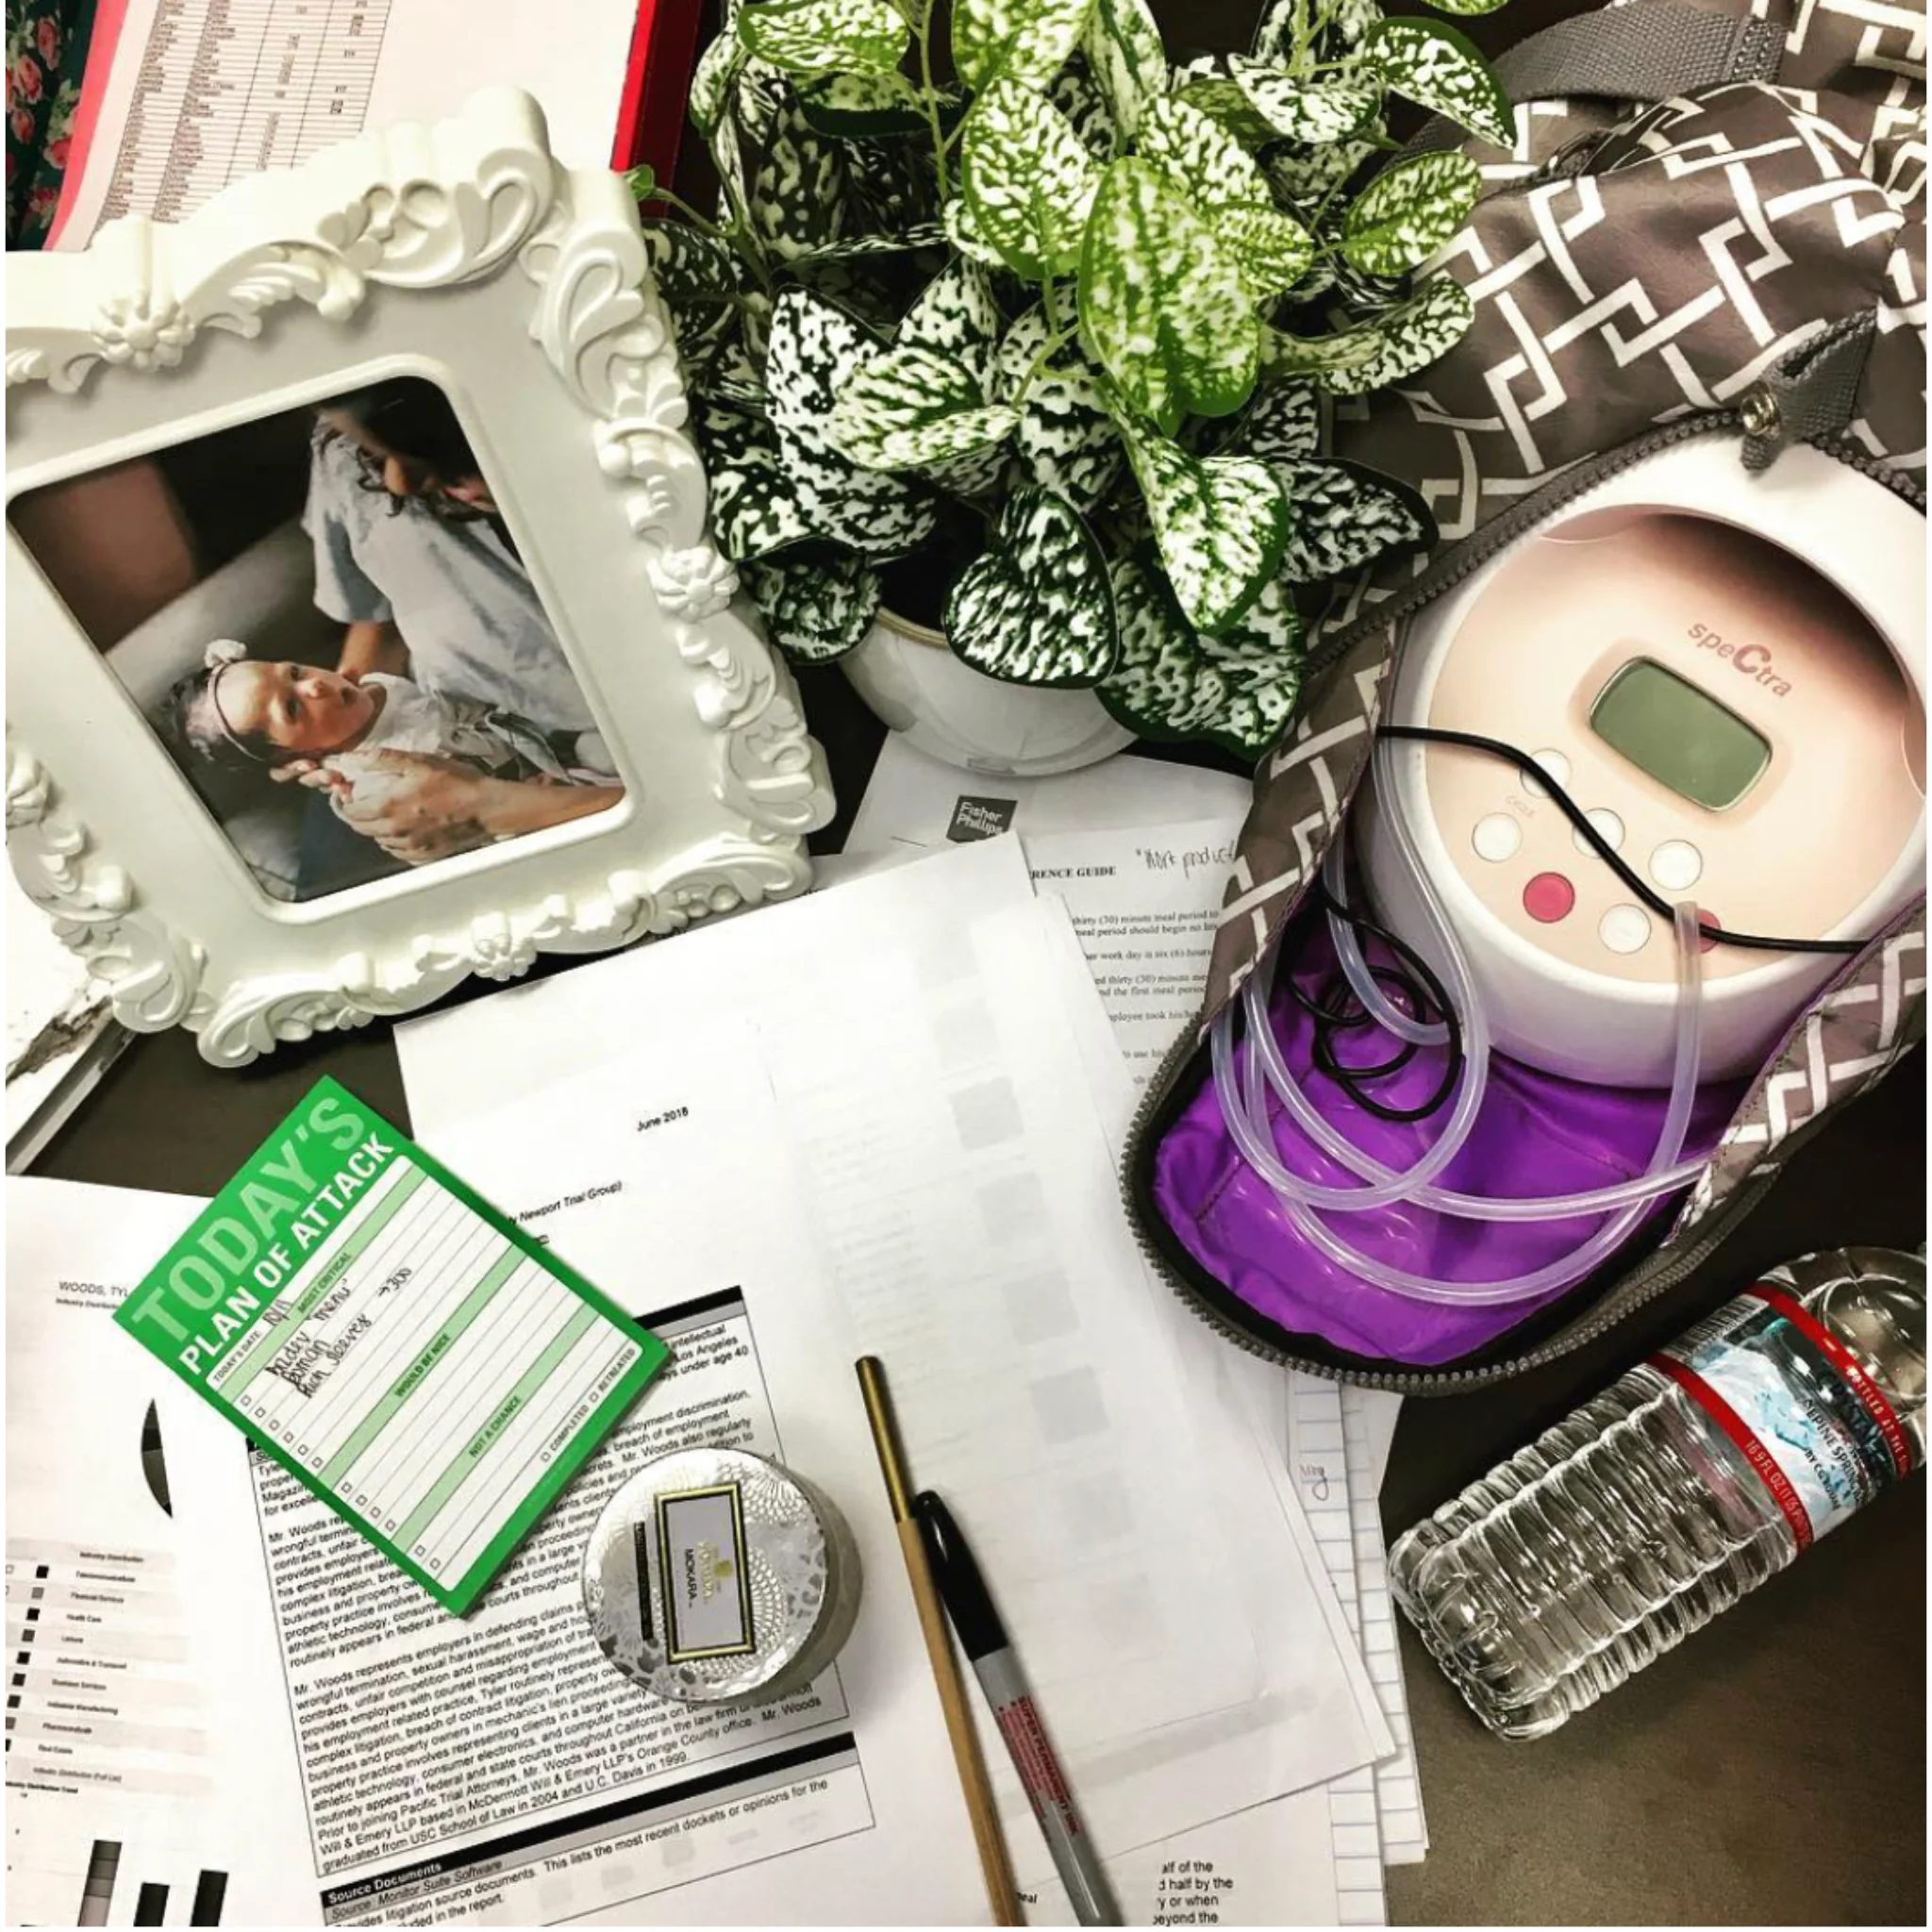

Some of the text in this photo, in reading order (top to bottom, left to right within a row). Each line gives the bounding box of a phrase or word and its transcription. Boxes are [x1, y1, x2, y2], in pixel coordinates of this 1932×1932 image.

[956, 814, 1005, 835] Phillips
[958, 802, 1003, 823] Fisher
[1076, 865, 1117, 877] GUIDE
[1097, 925, 1127, 940] period
[1130, 923, 1160, 935] should
[1101, 949, 1123, 960] work
[1125, 949, 1142, 961] day
[637, 1117, 661, 1132] June
[130, 1095, 366, 1339] TODAY'S
[520, 1179, 624, 1223] Newport Trial Group)
[177, 1284, 261, 1375] PLAN
[251, 1241, 297, 1291] OF
[291, 1132, 395, 1250] ATTACK
[296, 1251, 351, 1312] MOST CRITICAL
[393, 1333, 450, 1397] WOULD BE NICE
[676, 1334, 737, 1361] Los Angeles
[679, 1343, 749, 1374] under age 40
[548, 1347, 636, 1451] COMPLETED RETREATED
[675, 1387, 750, 1421] discrimination,
[1843, 1364, 1885, 1415] BOTTLED
[468, 1395, 521, 1457] NOT A CHANCE
[611, 1407, 729, 1452] breach of employment
[621, 1415, 752, 1463] Mr. Woods also regularly
[279, 1574, 375, 1614] complex litigation,
[685, 1548, 698, 1600] MOKARA
[293, 1599, 579, 1695] Mr. Woods represents employers in defending claims
[317, 1823, 343, 1840] Prior
[346, 1818, 358, 1830] to
[359, 1807, 398, 1828] joining
[399, 1794, 436, 1814] Pacific
[439, 1786, 463, 1803] Trial
[464, 1770, 519, 1797] Attorneys,
[523, 1763, 540, 1777] Mr.
[542, 1751, 582, 1772] Woods
[584, 1745, 607, 1758] was
[618, 1727, 658, 1751] partner
[660, 1724, 672, 1736] in
[673, 1717, 692, 1732] the
[691, 1710, 714, 1726] law
[713, 1703, 740, 1720] firm
[320, 1840, 341, 1855] Will
[355, 1824, 391, 1846] Emery
[393, 1816, 416, 1832] LLP
[419, 1806, 454, 1824] based
[455, 1802, 466, 1814] in
[467, 1783, 528, 1810] McDermott
[530, 1775, 551, 1790] Will
[564, 1760, 600, 1783] Emery
[602, 1751, 634, 1769] LLP's
[636, 1738, 678, 1761] Orange
[679, 1724, 722, 1748] County
[722, 1715, 752, 1732] office.
[762, 1706, 782, 1722] Mr.
[779, 1693, 824, 1715] Woods
[385, 1777, 827, 1922] litigation source documents. This lists the most recent dockets or opinions for the
[1178, 1860, 1213, 1874] of the
[327, 1859, 441, 1903] Source Documents
[331, 1857, 502, 1918] Source: Monitor Suite Software
[1169, 1877, 1234, 1891] half by the
[1170, 1895, 1219, 1907] or when
[434, 1890, 503, 1922] in the report.
[1198, 1911, 1219, 1924] the
